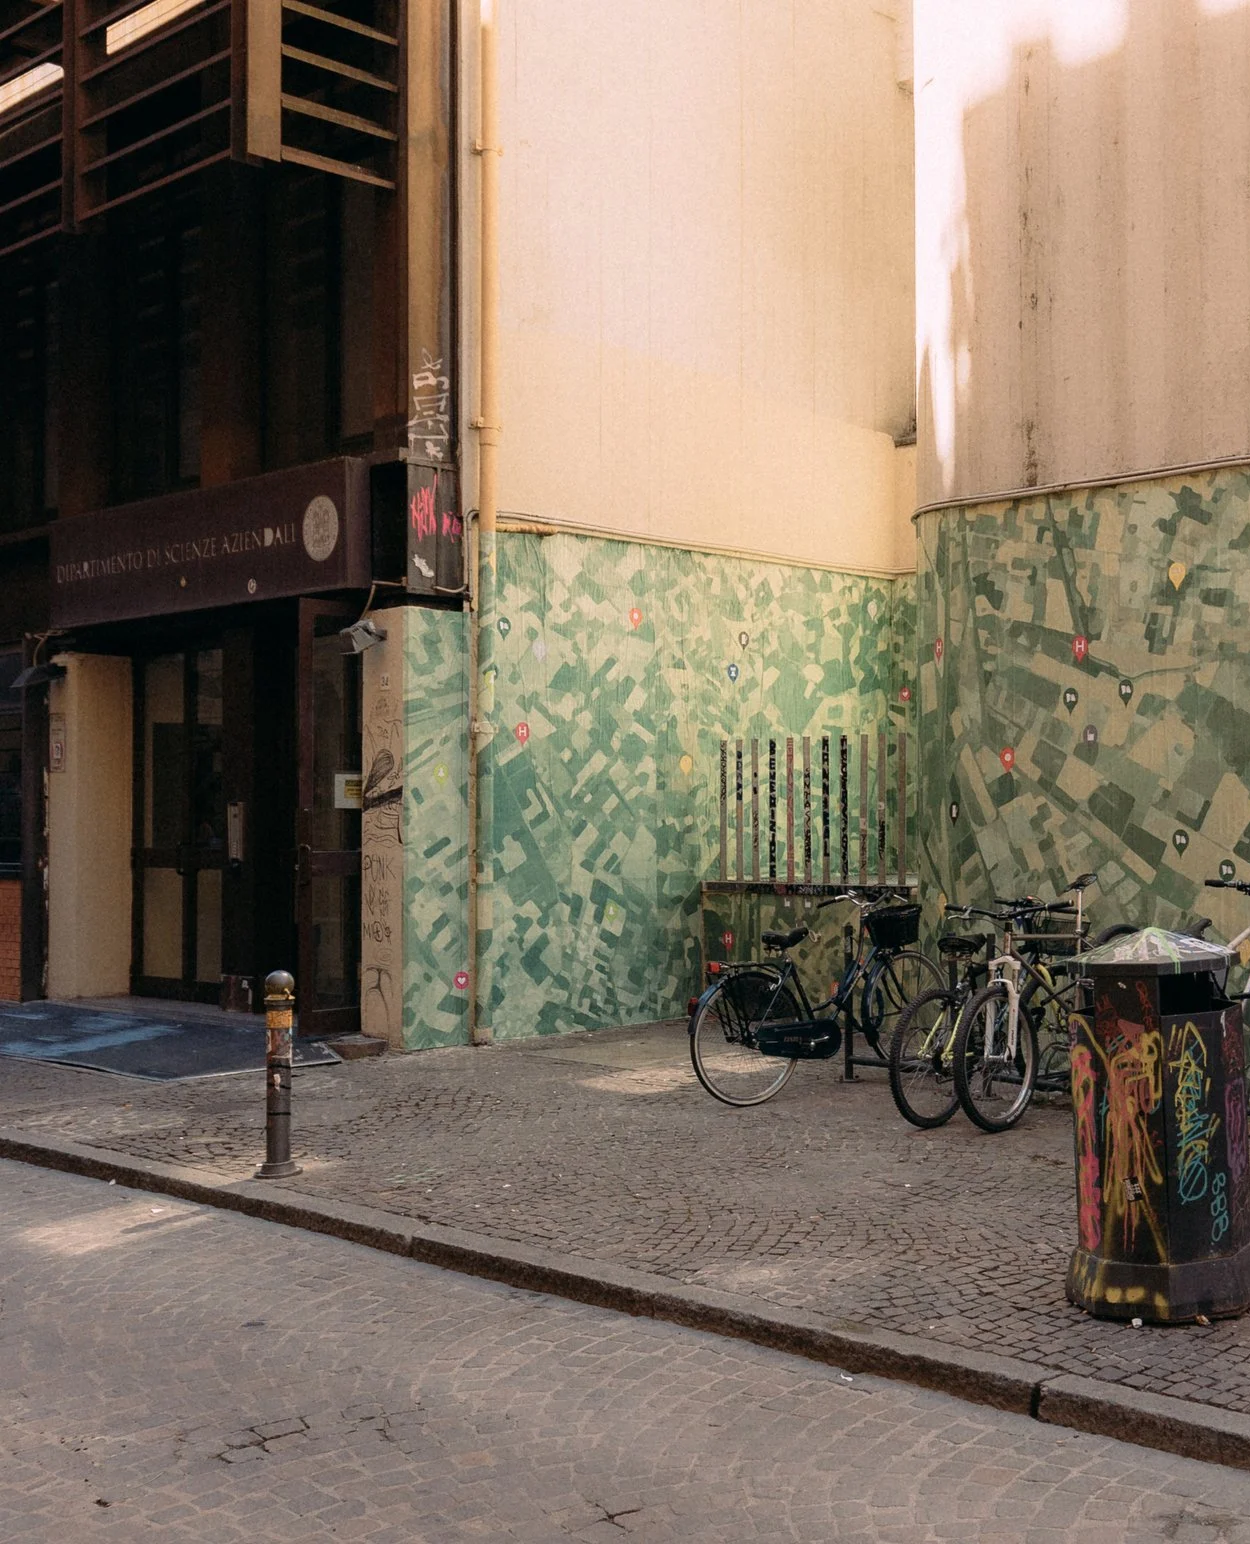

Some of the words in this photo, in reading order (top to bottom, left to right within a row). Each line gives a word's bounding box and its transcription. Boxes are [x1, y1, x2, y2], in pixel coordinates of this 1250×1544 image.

[57, 551, 144, 584] DIPARTIMENTO
[146, 547, 161, 569] DI
[163, 536, 218, 566] SCIENZE
